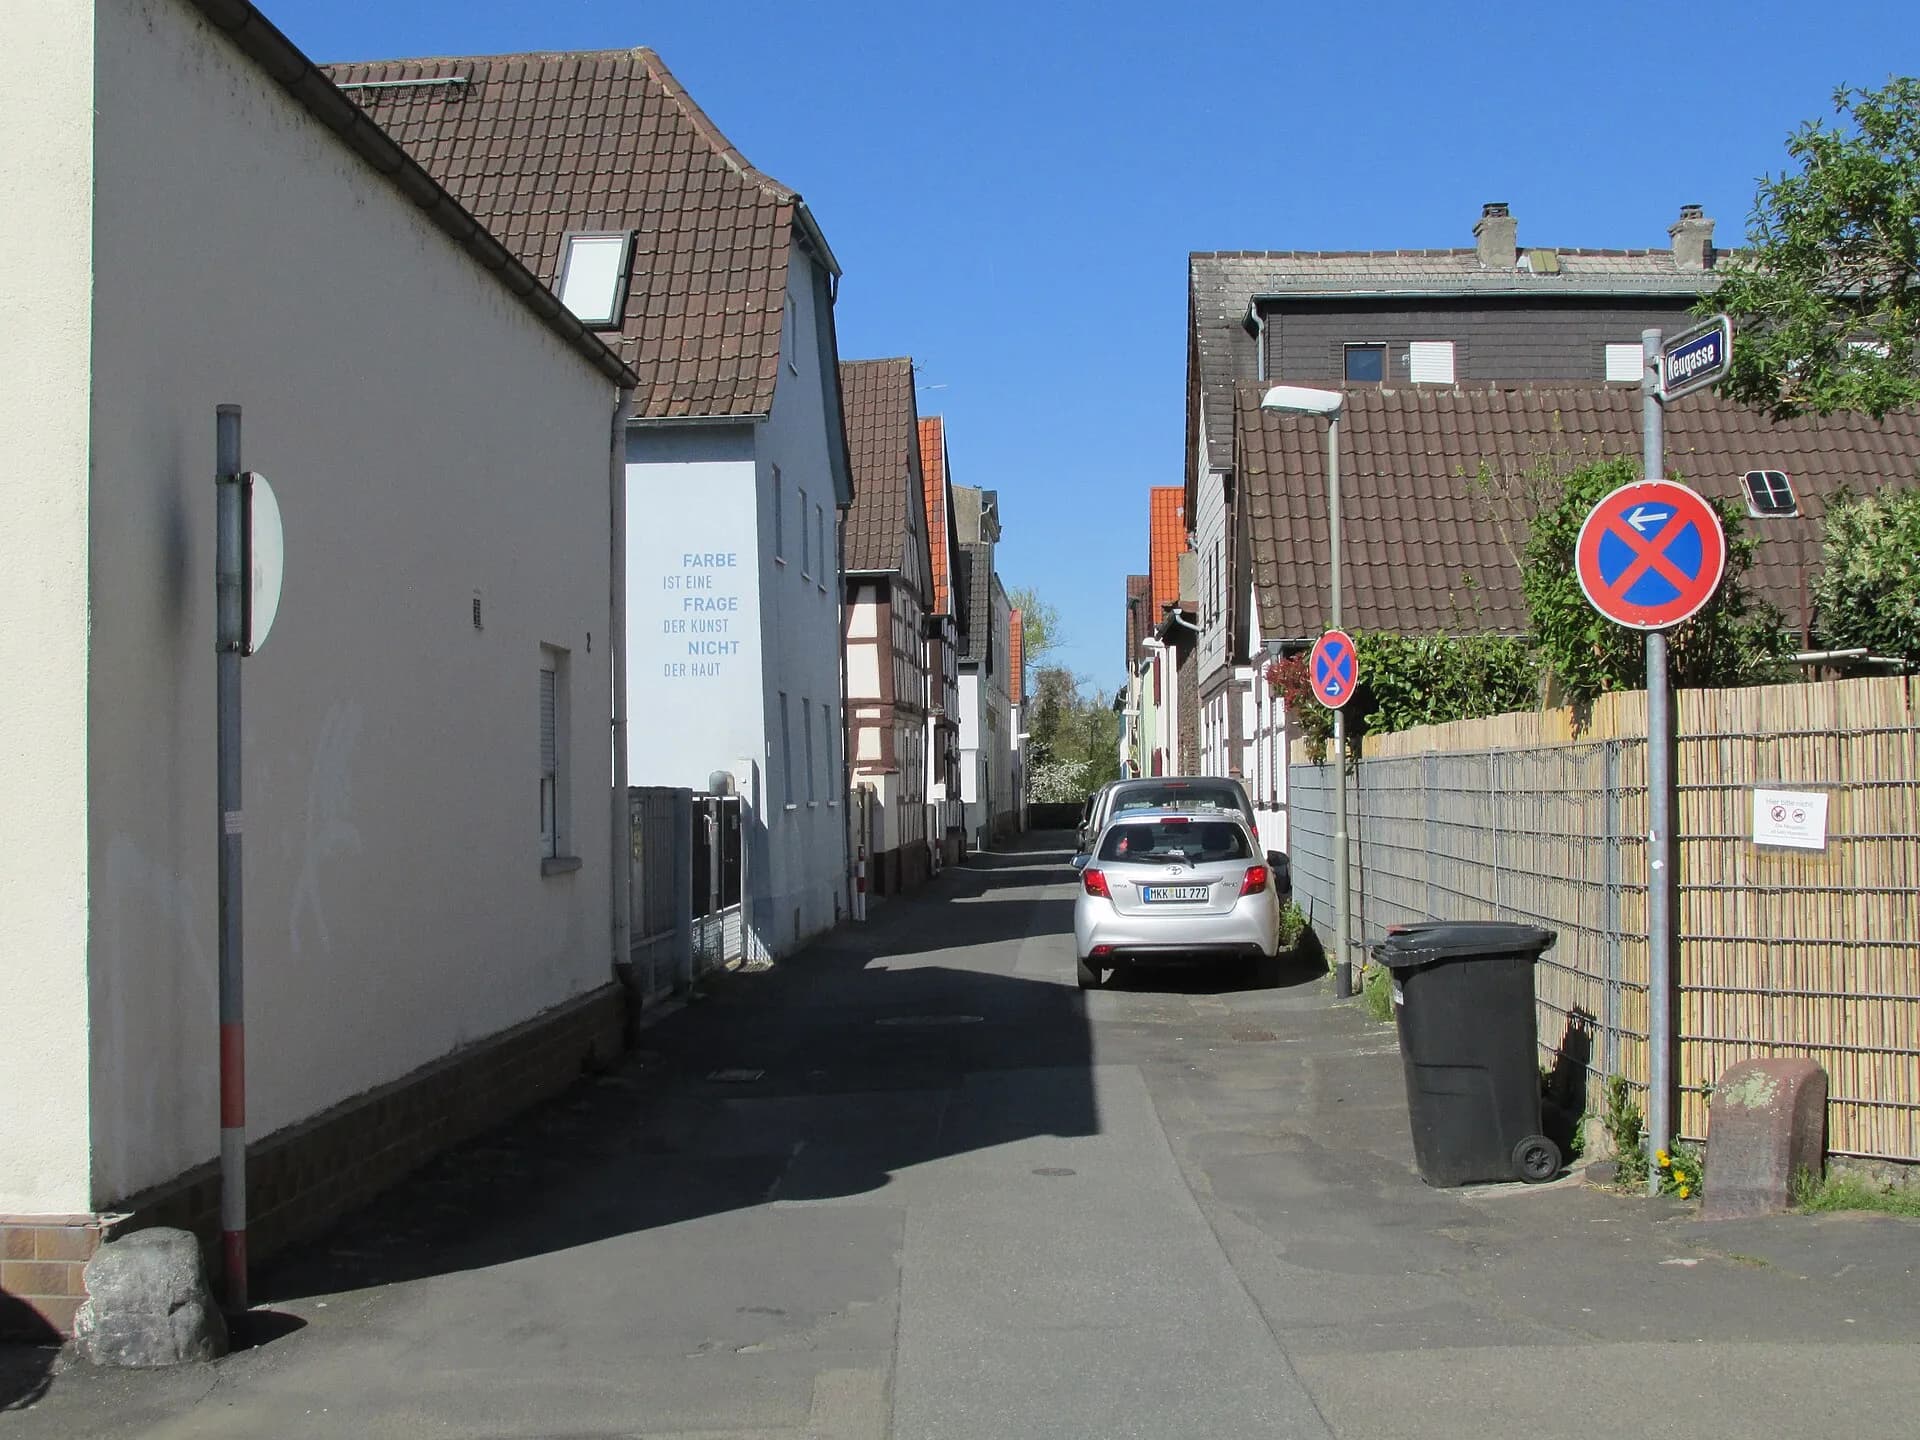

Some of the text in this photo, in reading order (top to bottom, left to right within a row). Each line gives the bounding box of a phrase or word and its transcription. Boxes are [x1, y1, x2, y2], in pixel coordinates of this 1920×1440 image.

[1668, 344, 1714, 381] Neugasse
[684, 553, 737, 567] FARBE
[663, 575, 712, 589] IST EINE
[684, 597, 738, 611] FRAGE
[663, 618, 729, 633] DER KUNST
[688, 640, 740, 655] NICHT
[664, 662, 721, 677] DER HAUT
[1150, 888, 1168, 899] MKK
[1190, 888, 1207, 898] 777
